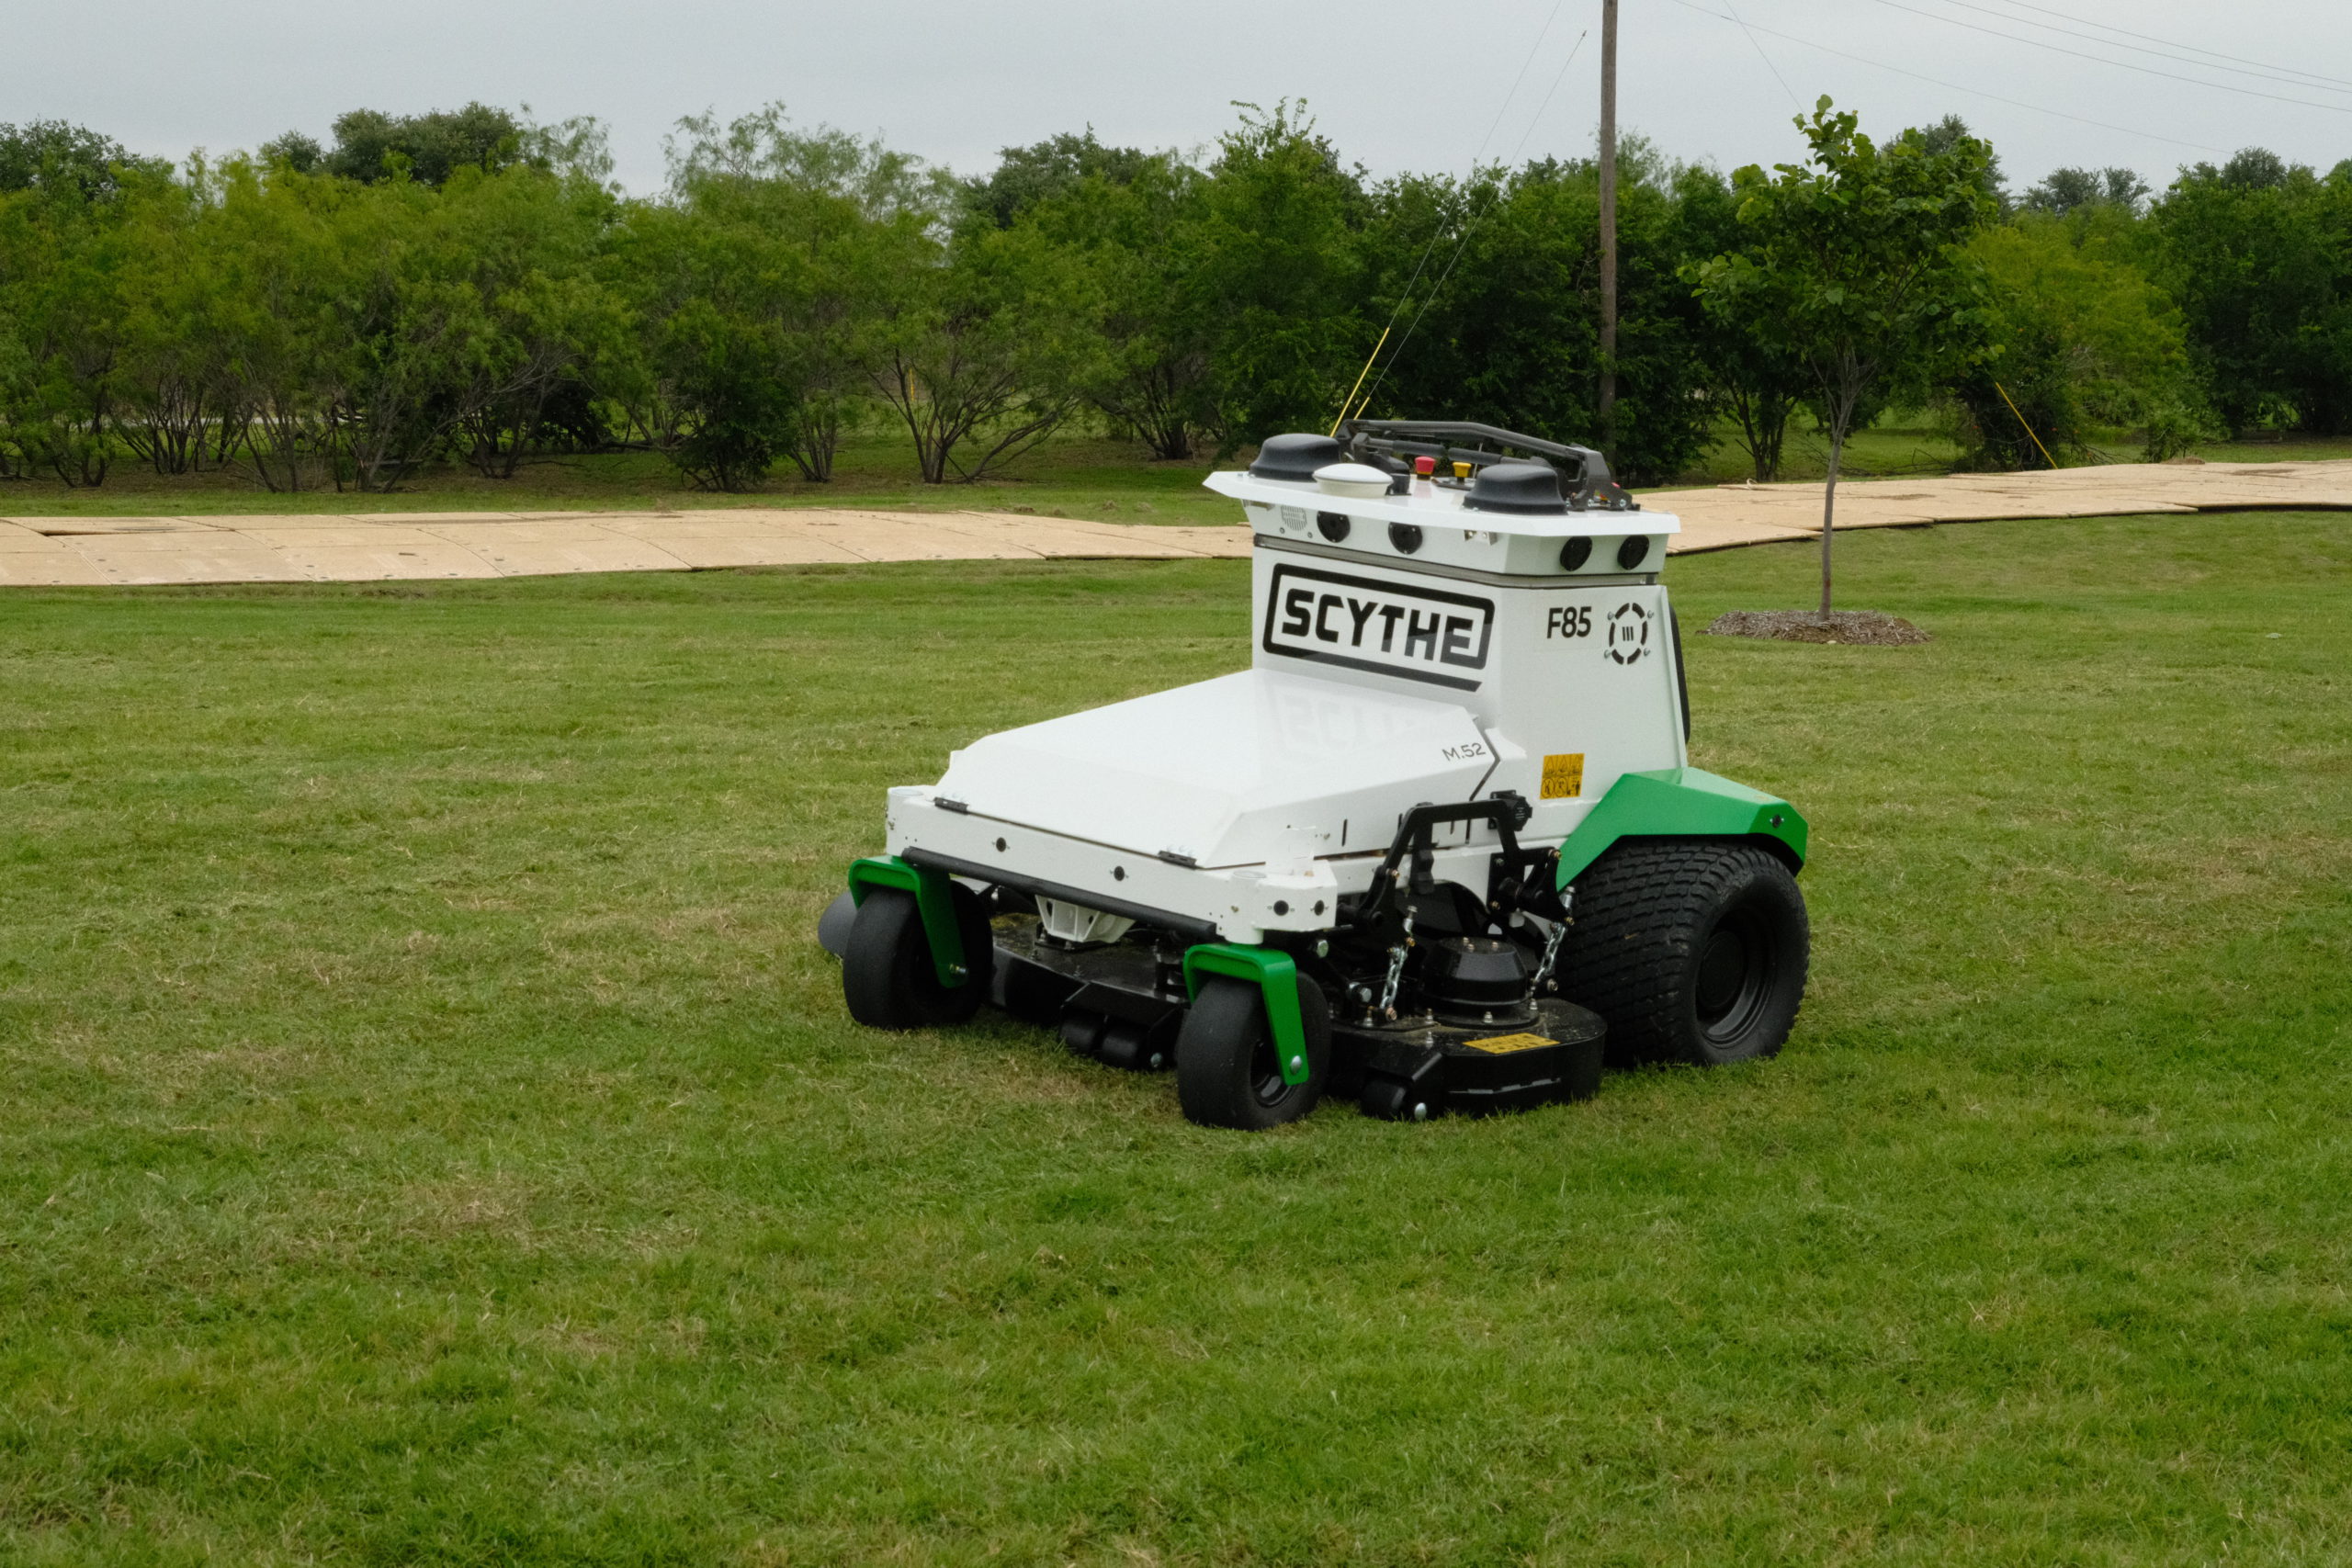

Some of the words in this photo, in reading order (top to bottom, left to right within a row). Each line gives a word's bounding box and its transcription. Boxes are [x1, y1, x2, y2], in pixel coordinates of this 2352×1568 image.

[1282, 588, 1477, 667] SCYTHE
[1546, 605, 1592, 638] F85
[1442, 742, 1487, 761] M.52
